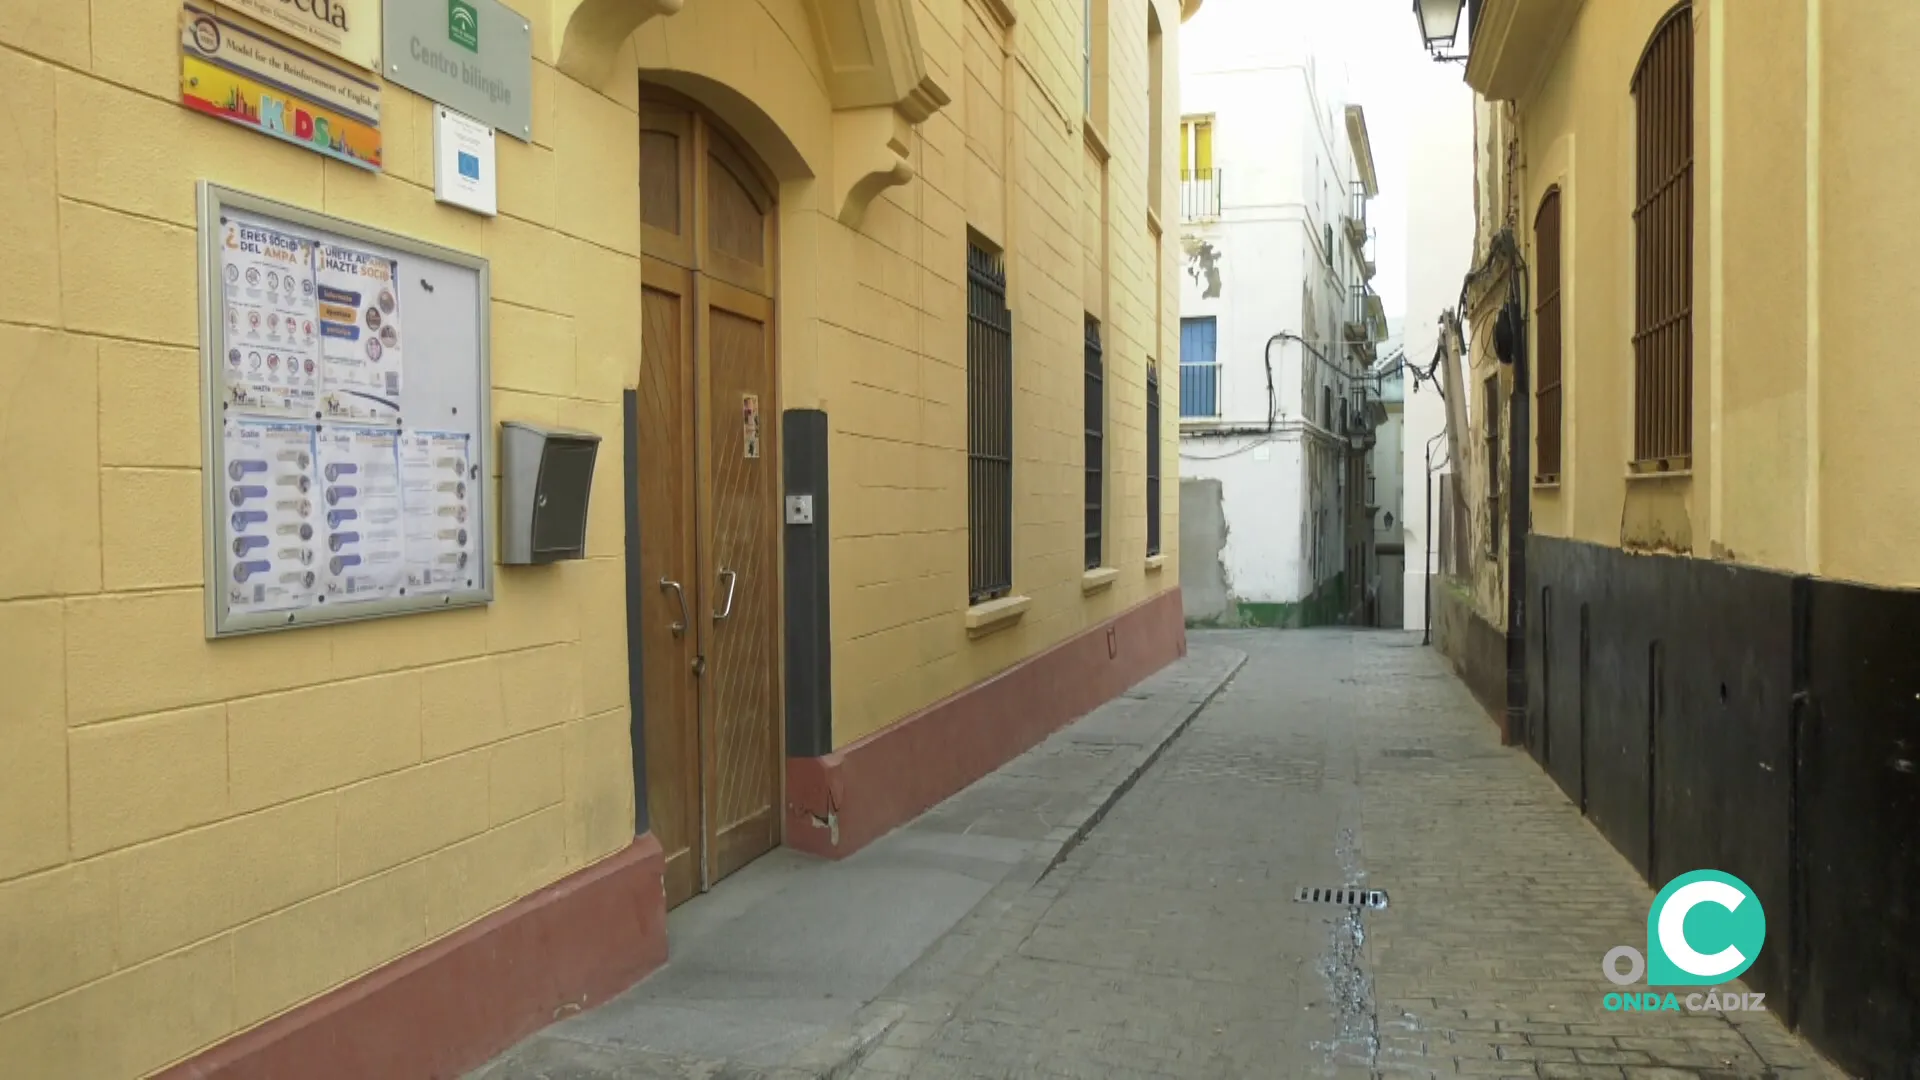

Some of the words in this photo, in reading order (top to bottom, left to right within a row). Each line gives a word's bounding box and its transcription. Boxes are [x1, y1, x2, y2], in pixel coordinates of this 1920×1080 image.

[226, 38, 253, 58] Model
[255, 48, 267, 64] for
[268, 57, 281, 69] the
[283, 61, 337, 92] Reinforcement
[338, 86, 347, 97] of
[347, 88, 373, 108] English
[410, 35, 458, 78] Centro
[462, 61, 512, 106] bilingüe
[240, 229, 267, 244] ERES
[240, 241, 262, 254] DEL
[264, 247, 298, 264] AMPA
[325, 258, 358, 275] HAZTE
